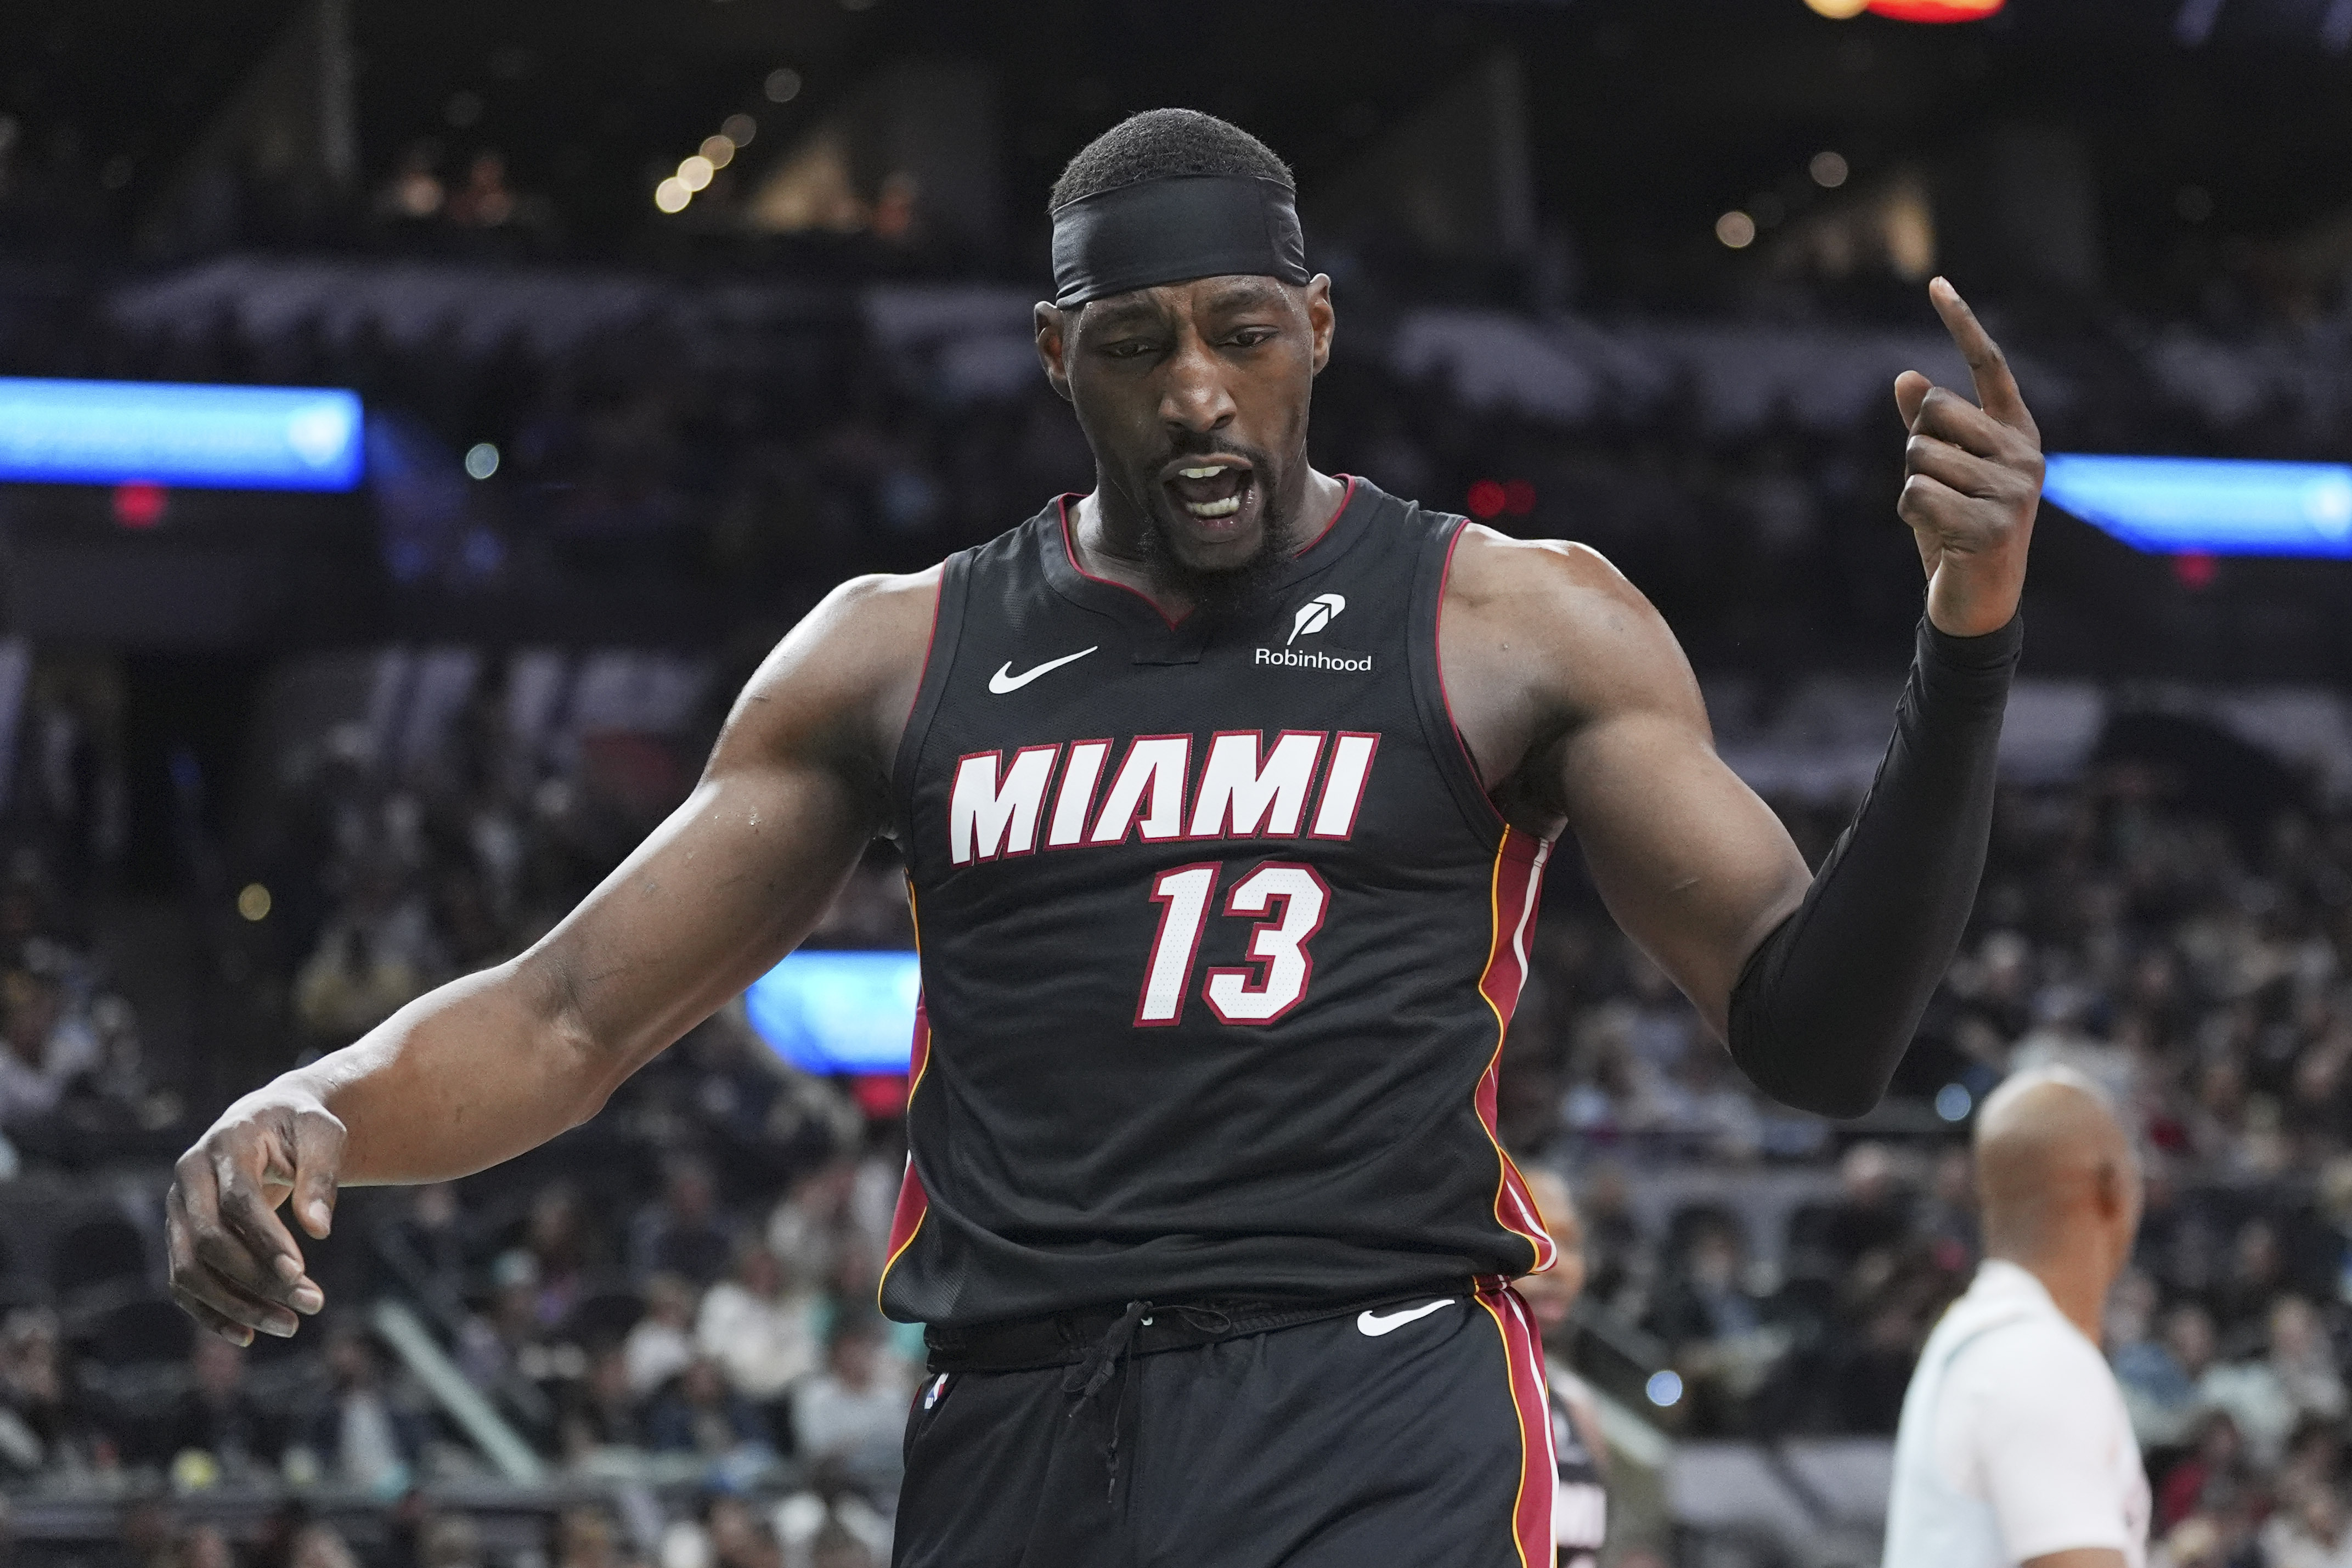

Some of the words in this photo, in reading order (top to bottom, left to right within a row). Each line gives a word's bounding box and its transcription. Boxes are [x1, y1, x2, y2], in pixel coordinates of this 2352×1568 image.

[1255, 648, 1372, 671] Robinhood
[949, 730, 1381, 867] MIAMI
[1132, 860, 1330, 1027] 13
